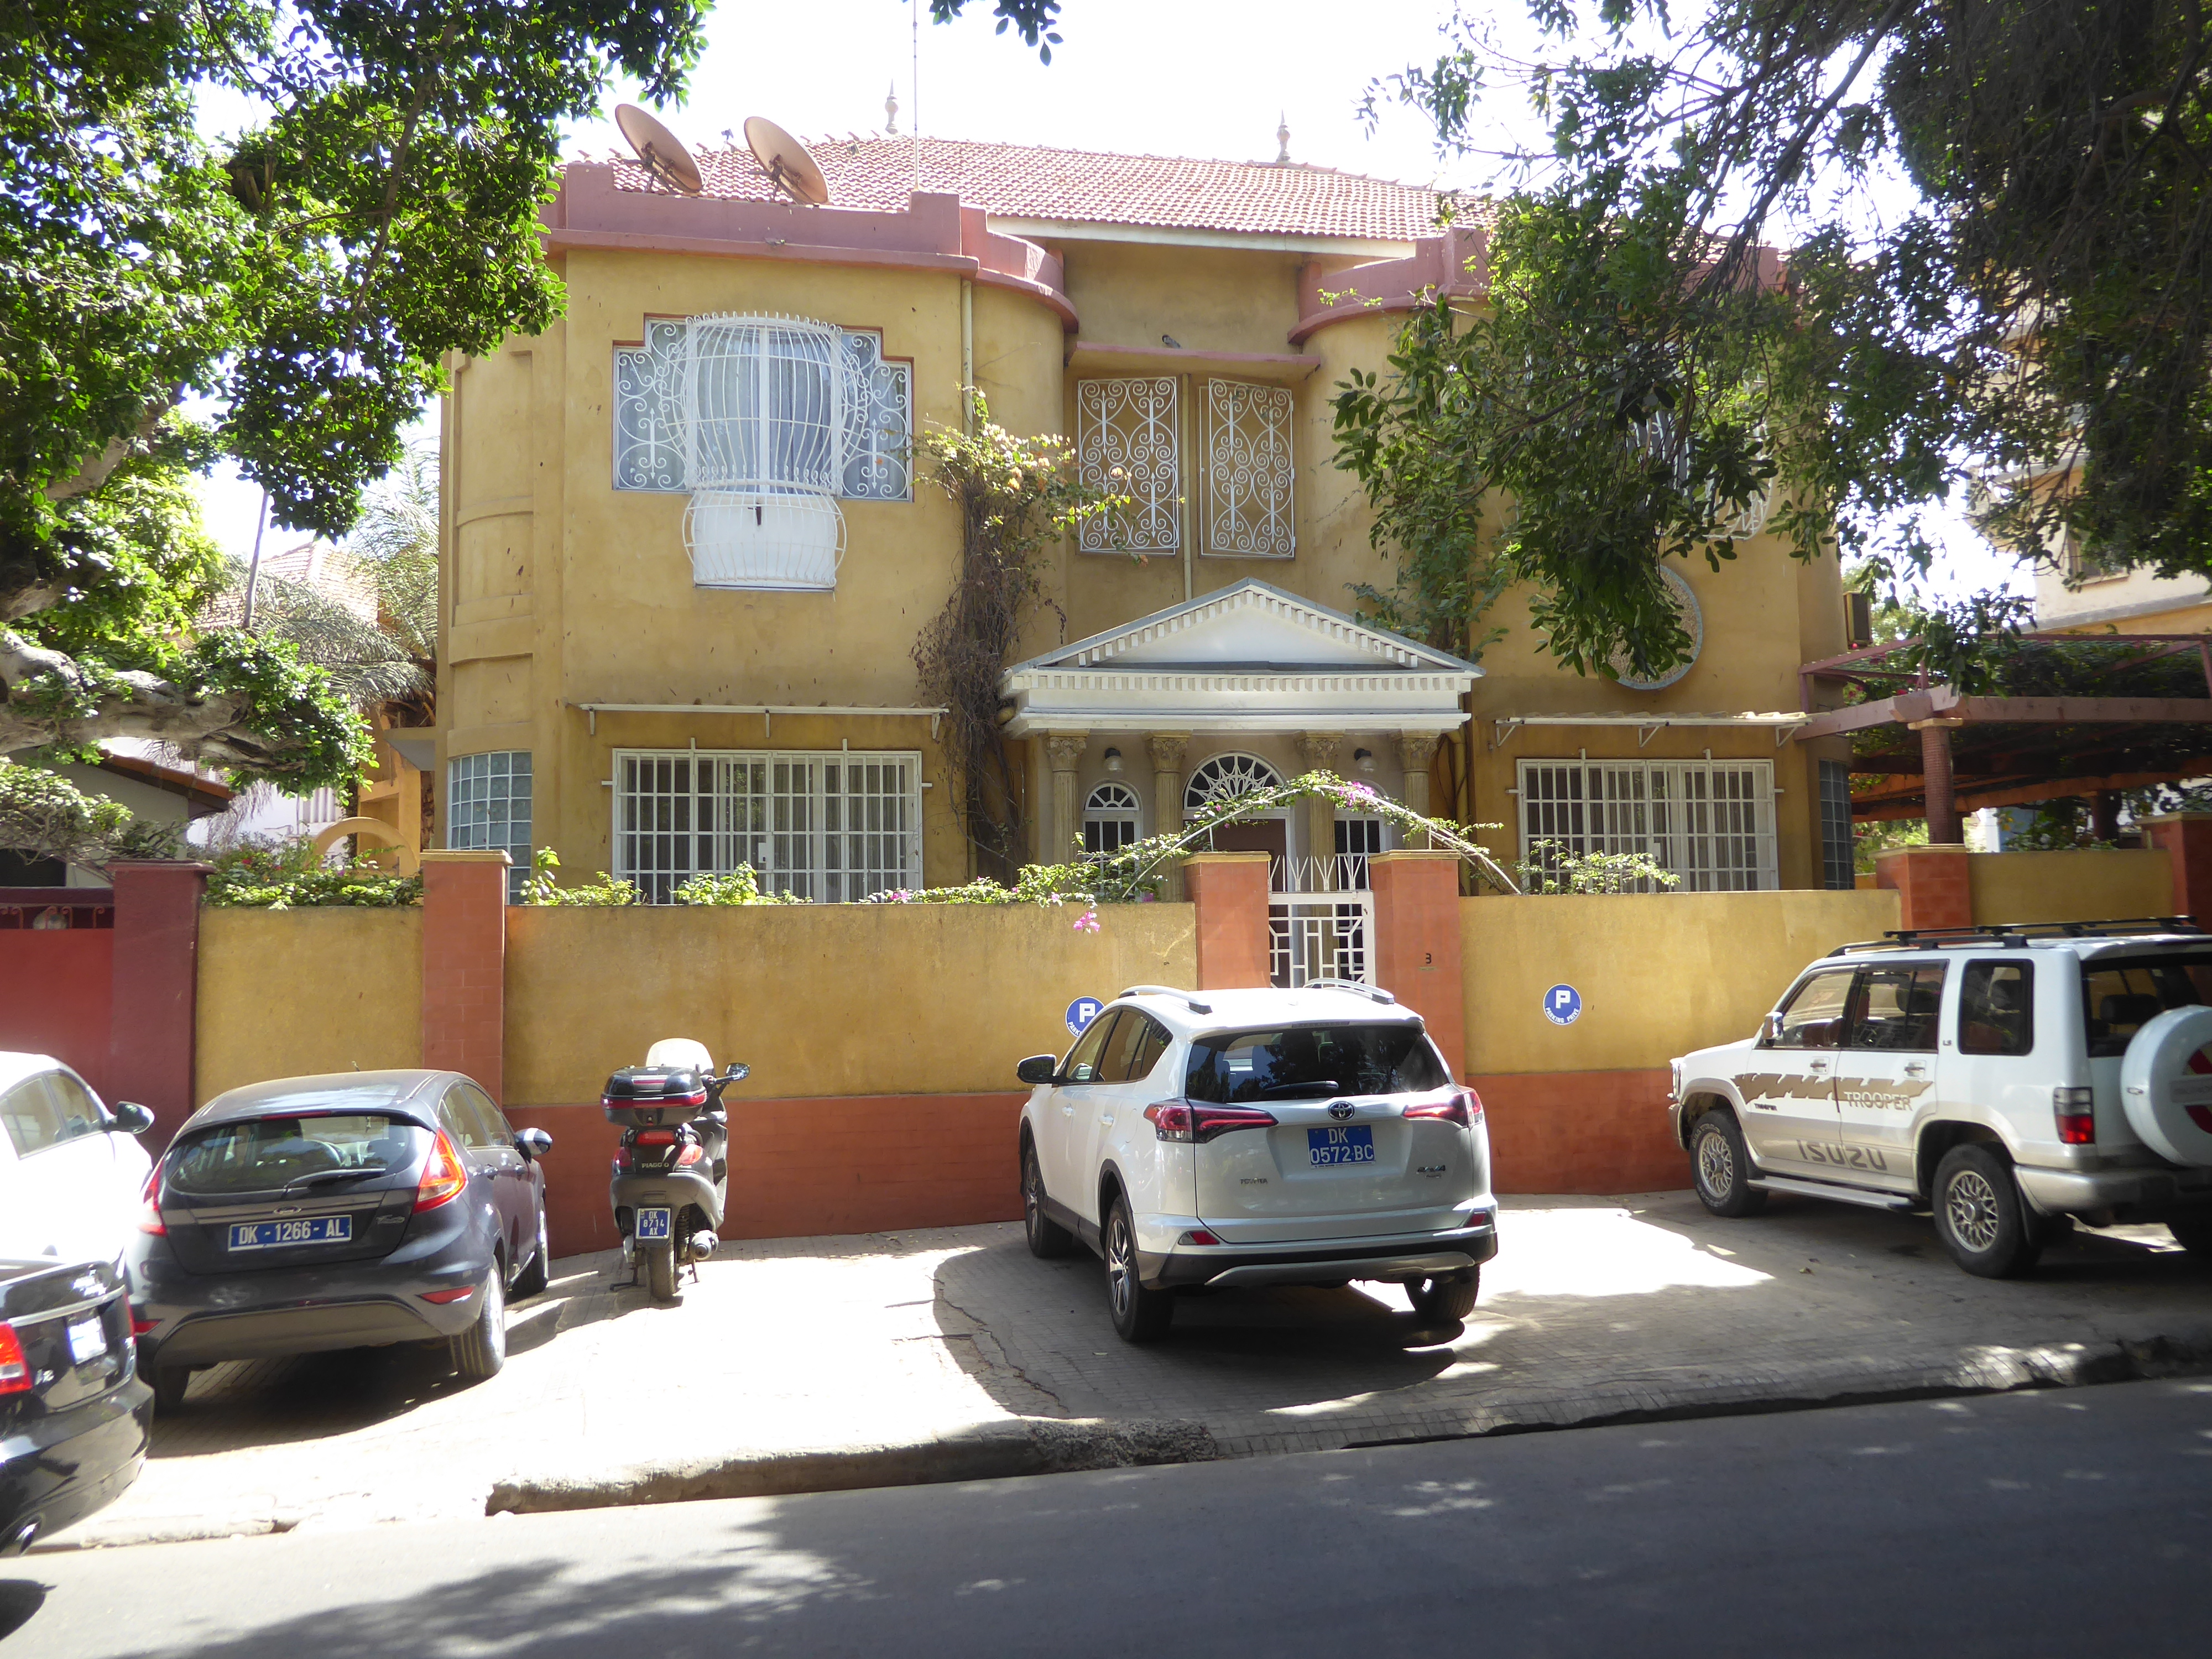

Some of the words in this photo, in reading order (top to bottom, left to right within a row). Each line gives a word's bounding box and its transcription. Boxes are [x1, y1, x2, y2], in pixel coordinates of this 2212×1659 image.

[1426, 953, 1432, 964] 3
[1556, 990, 1571, 1009] P
[1079, 1003, 1095, 1022] P
[1546, 1007, 1564, 1023] PARKING
[1068, 1021, 1082, 1036] PARK
[1844, 1091, 1913, 1112] TROOPER
[1328, 1128, 1348, 1144] DK
[1797, 1139, 1887, 1171] ISUZU
[649, 1211, 658, 1219] DK
[238, 1225, 258, 1245] DK
[275, 1221, 311, 1242] 1266
[326, 1218, 345, 1238] AL
[643, 1219, 665, 1228] 8714
[649, 1227, 658, 1235] AX
